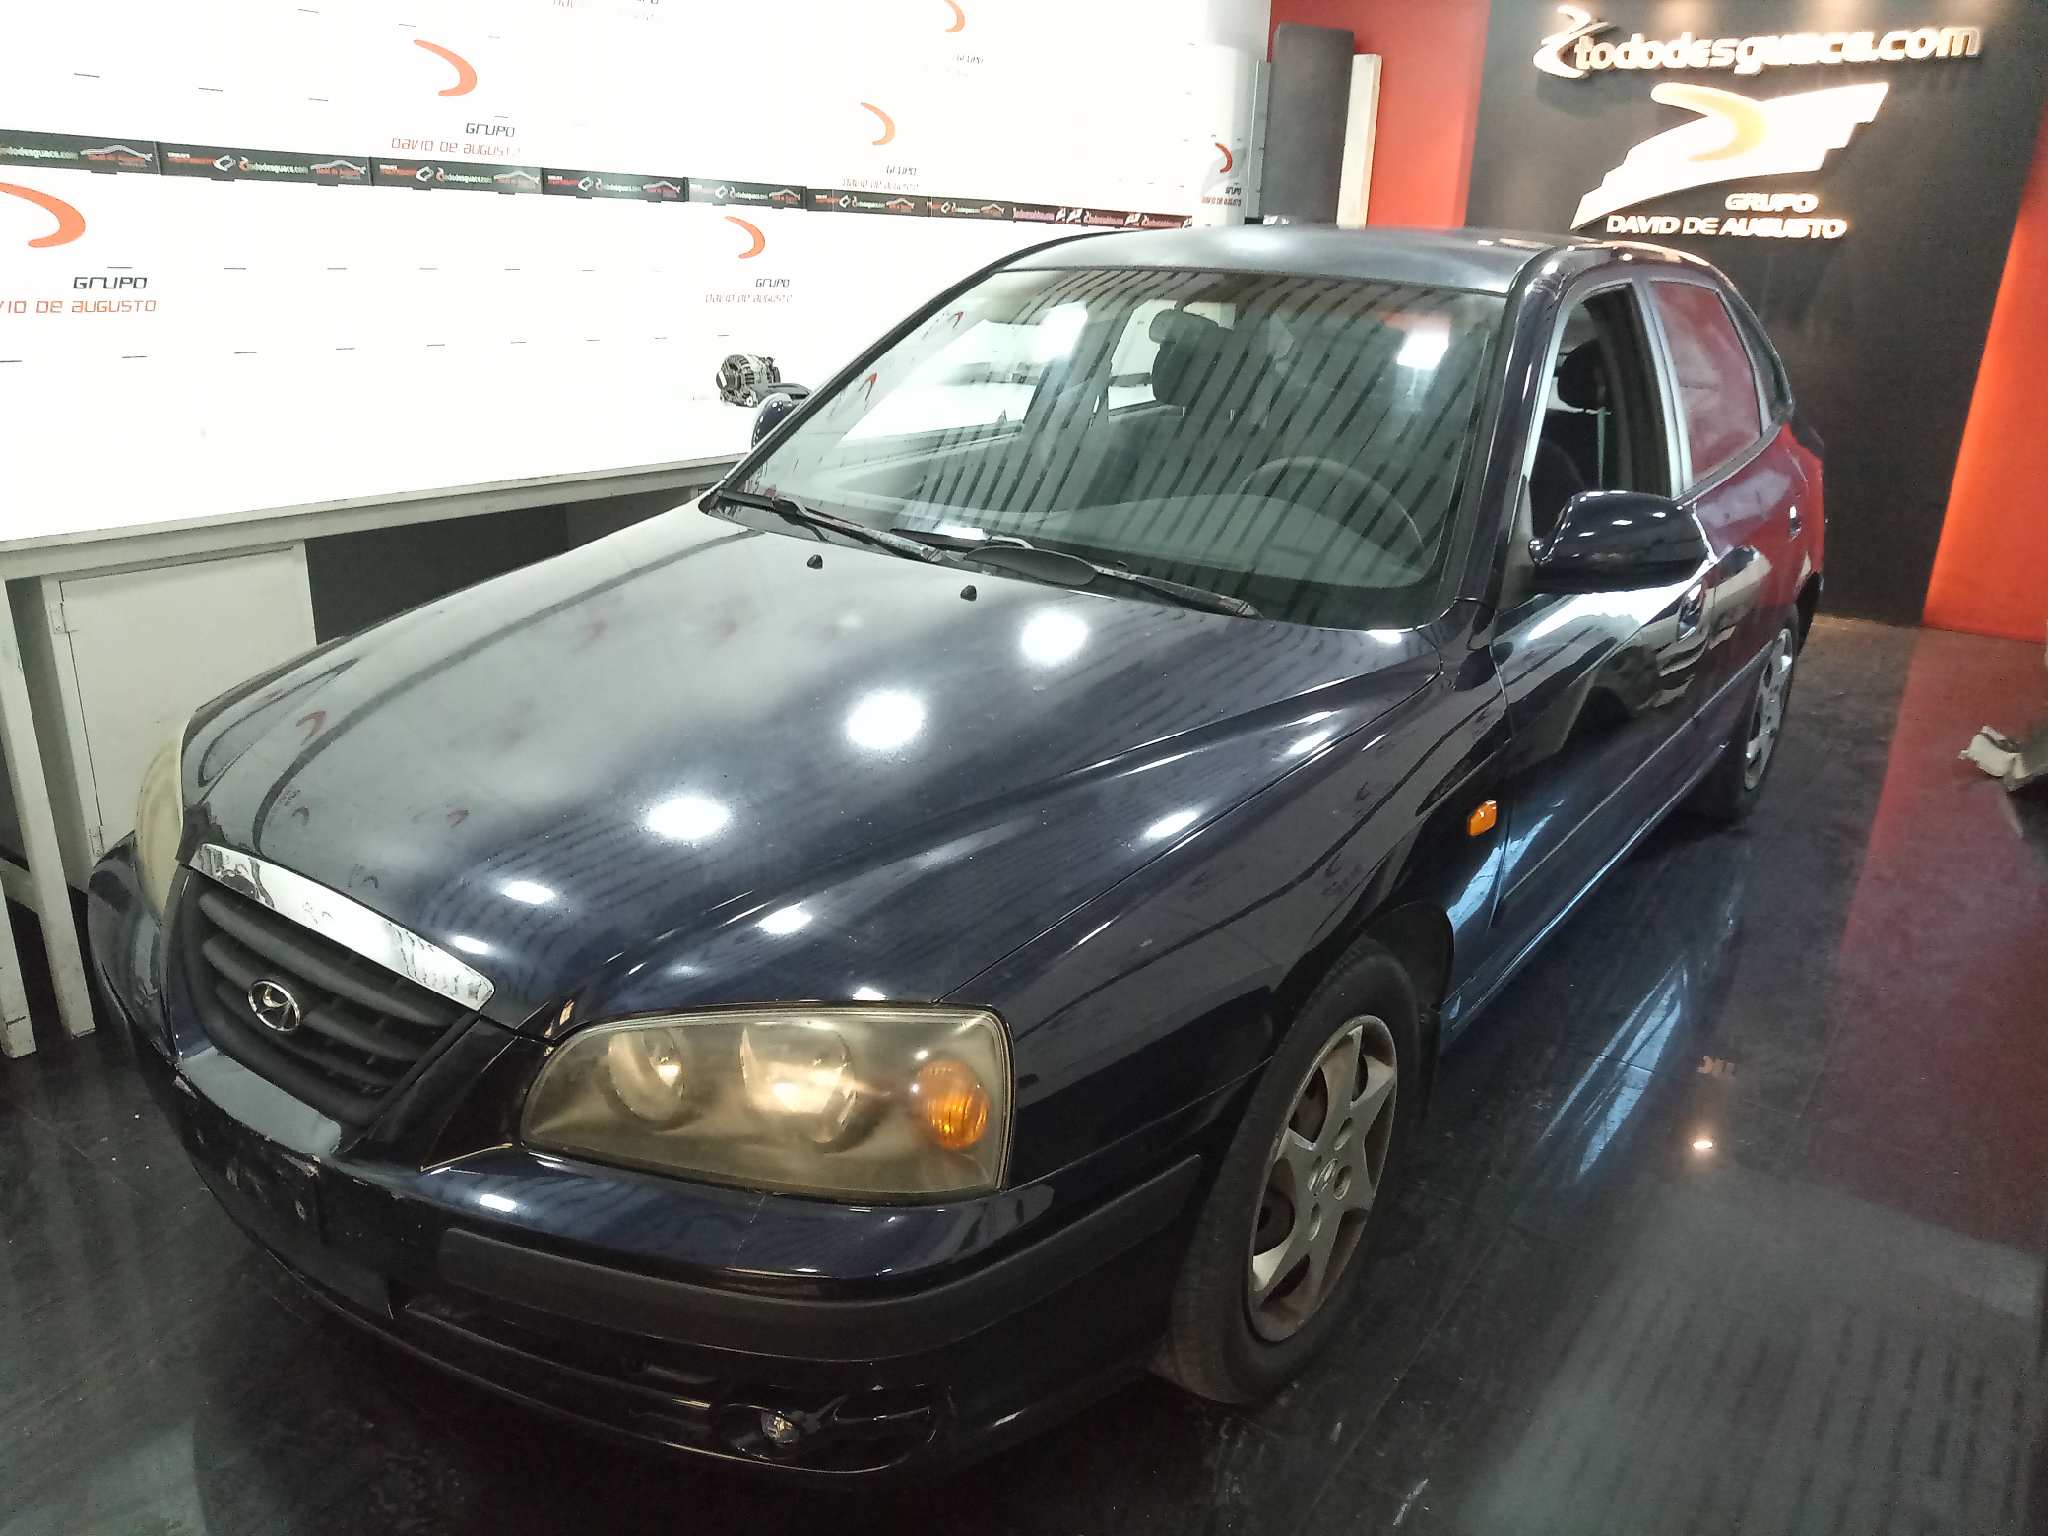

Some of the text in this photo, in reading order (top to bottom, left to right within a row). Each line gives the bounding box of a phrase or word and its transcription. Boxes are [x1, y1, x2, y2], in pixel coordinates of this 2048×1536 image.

[1724, 192, 1819, 214] GRUPO
[1606, 215, 1848, 239] DAVID DE AUGUSTO
